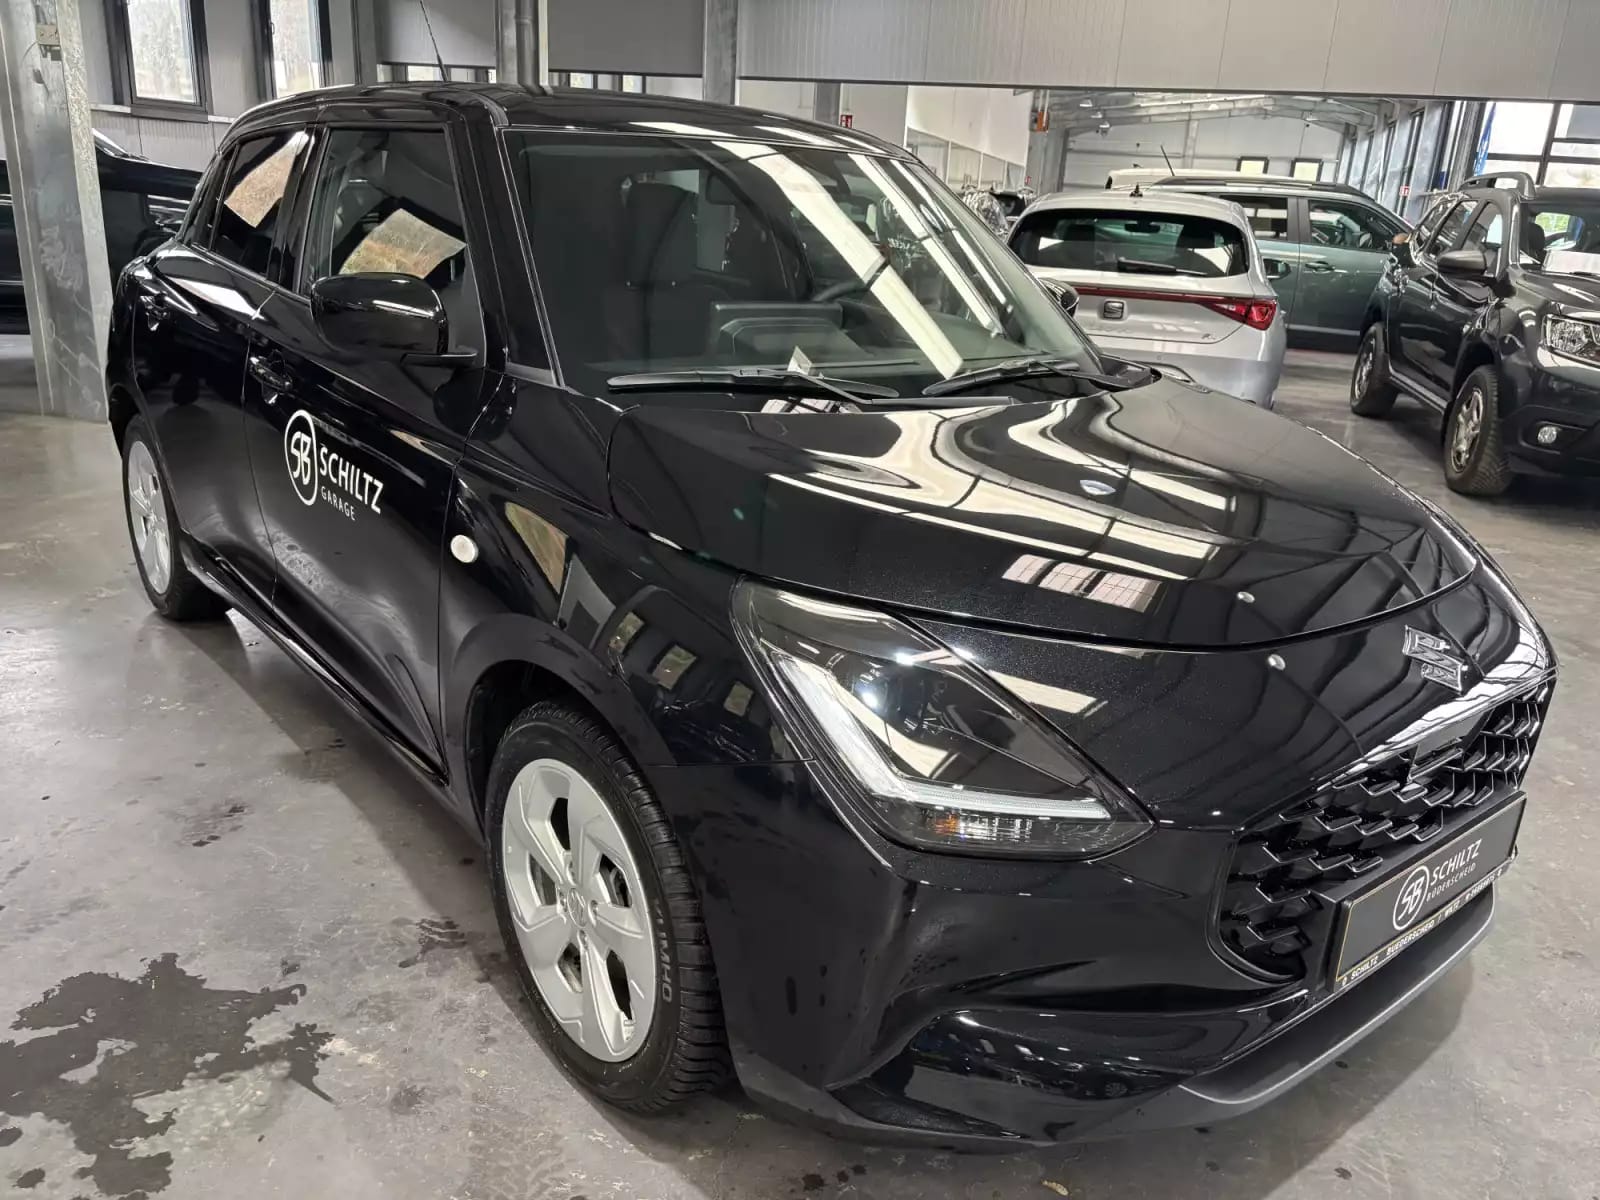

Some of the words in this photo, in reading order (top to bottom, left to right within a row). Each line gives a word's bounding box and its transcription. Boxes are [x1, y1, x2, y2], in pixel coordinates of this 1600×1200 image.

[320, 446, 384, 515] SCHILTZ
[321, 486, 356, 521] GARAGE
[1430, 838, 1482, 887] SCHILTZ
